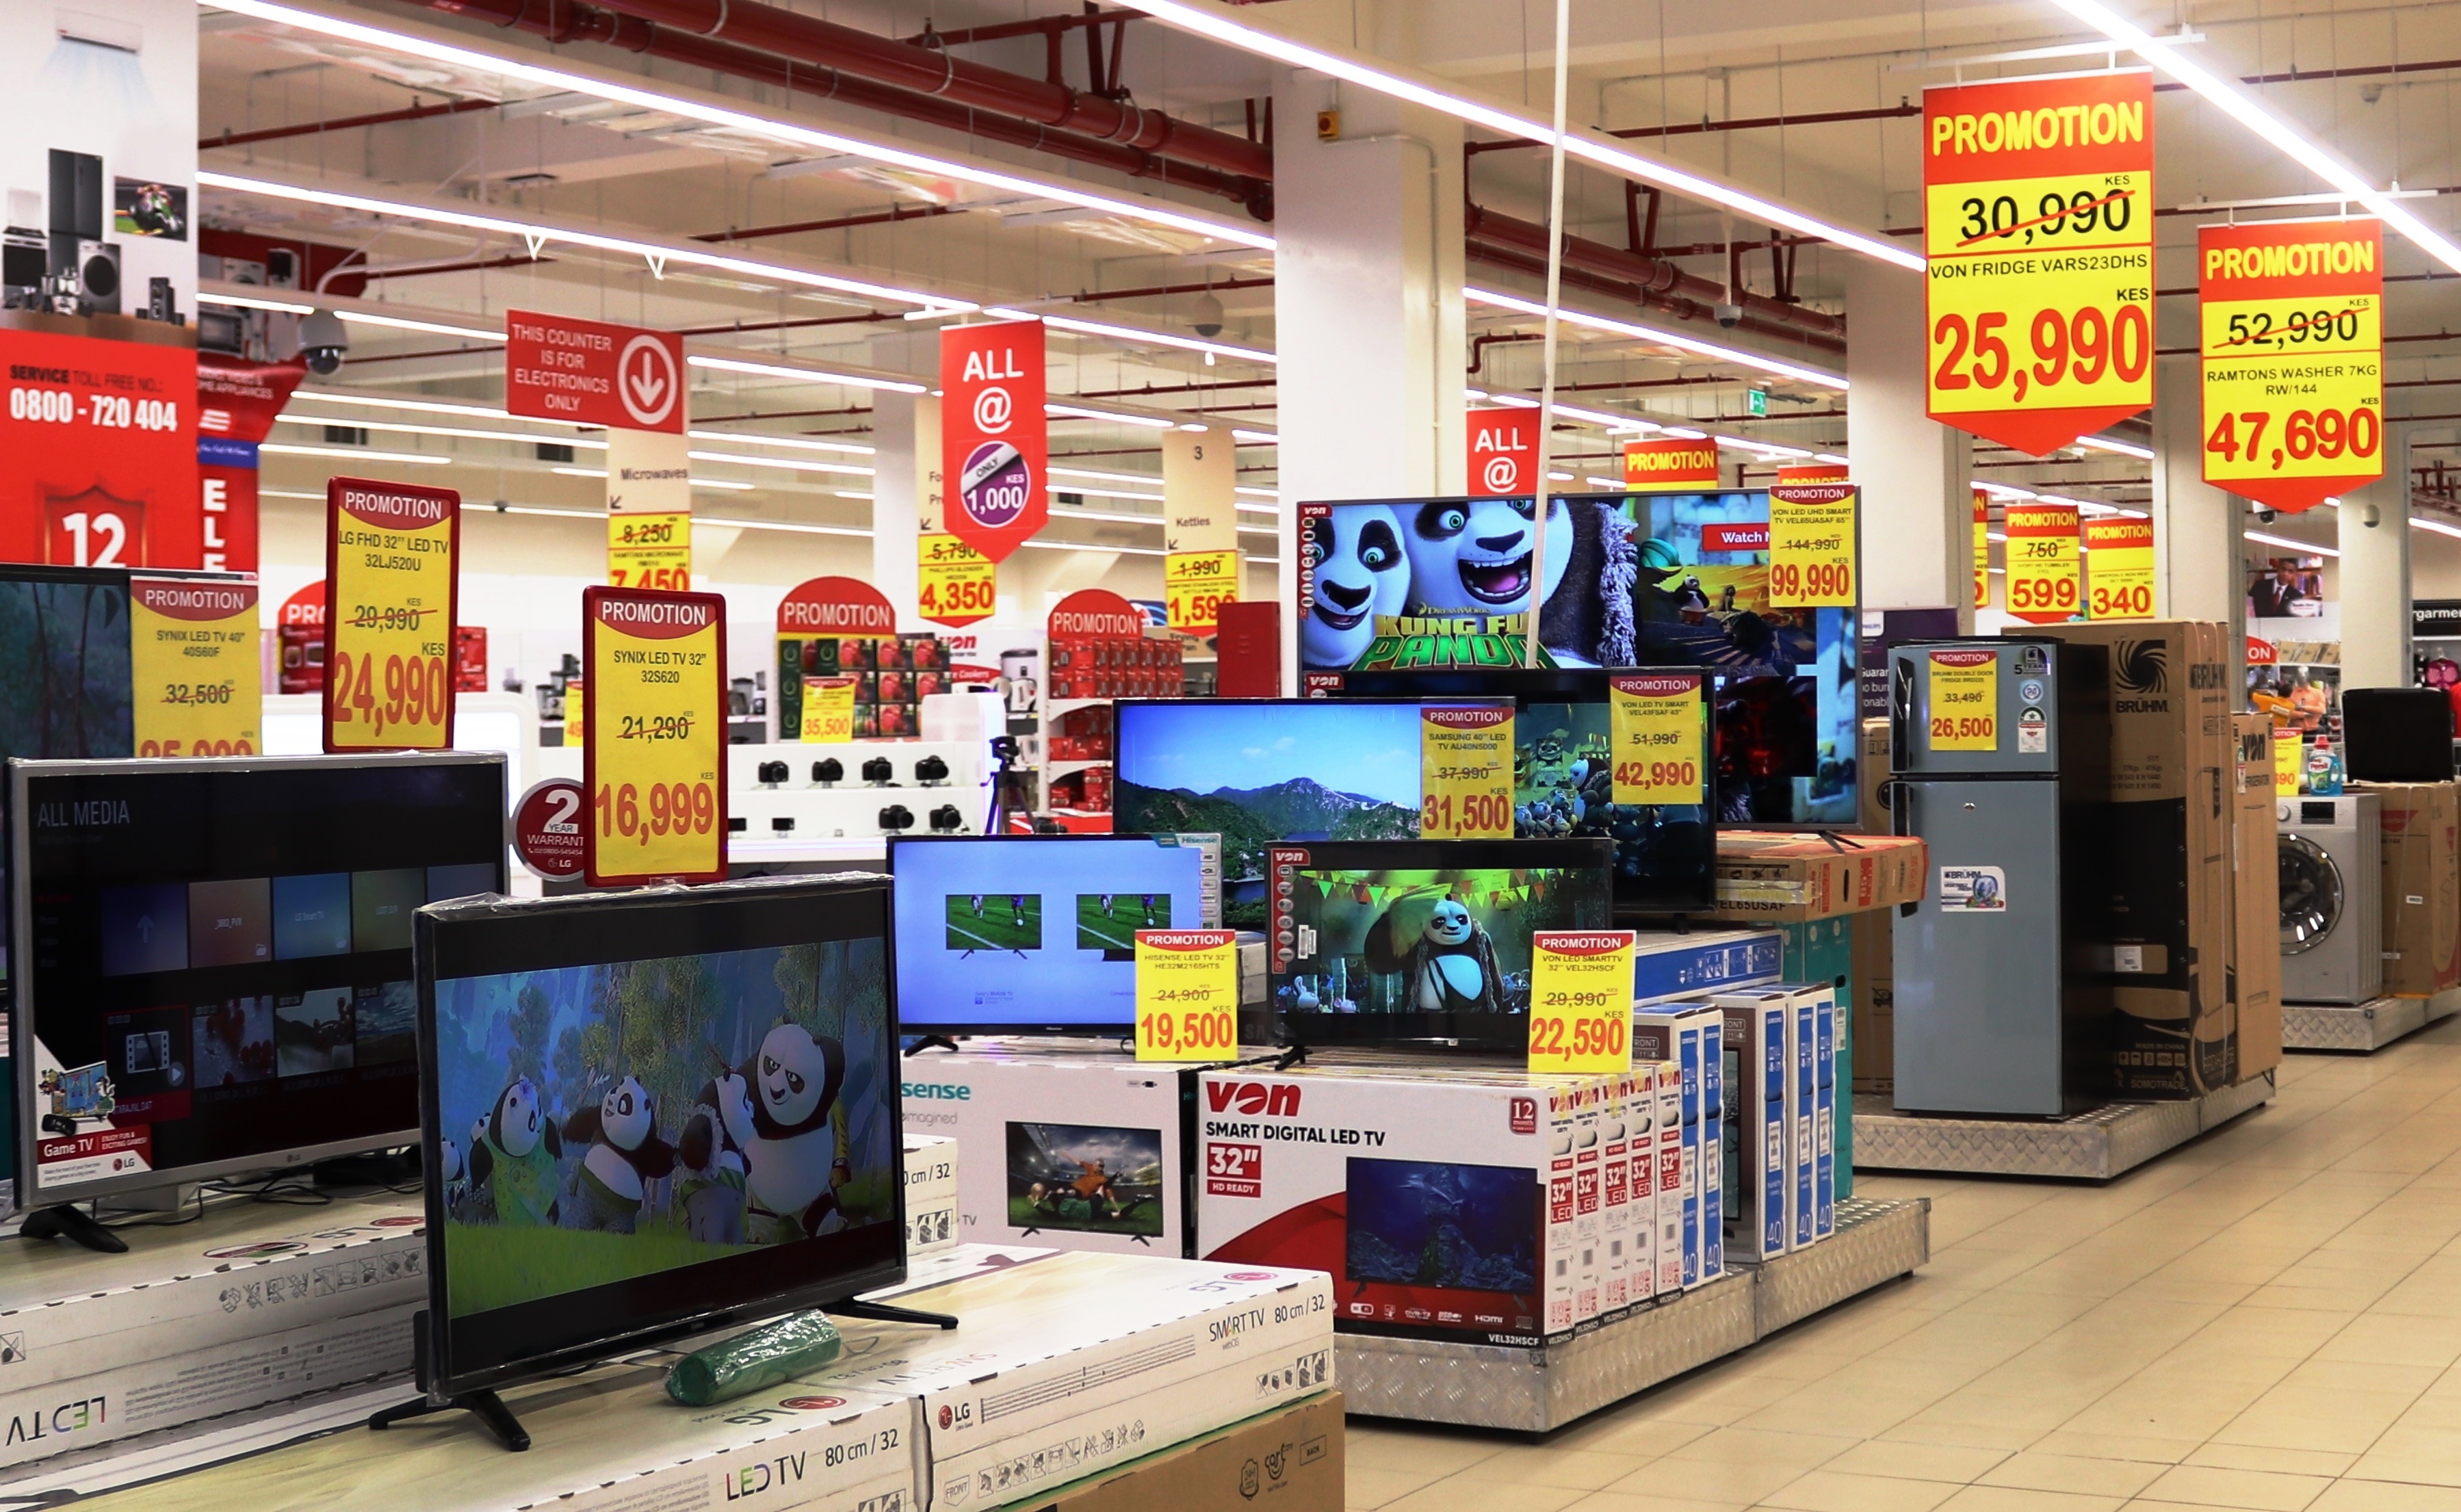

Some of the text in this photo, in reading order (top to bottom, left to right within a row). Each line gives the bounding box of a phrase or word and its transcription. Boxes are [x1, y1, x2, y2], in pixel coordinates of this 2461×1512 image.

[1933, 101, 2143, 157] PROMOTION
[2105, 176, 2131, 186] KES
[1962, 190, 2131, 245] 30,990
[1931, 255, 2148, 279] VON FRIDGE VARS23DHS
[2206, 240, 2373, 280] PROMOTION
[2117, 288, 2149, 302] KES
[2349, 298, 2369, 307] KES
[512, 324, 612, 352] THIS COUNTER
[2228, 309, 2358, 350] 52,990
[541, 350, 585, 369] IS FOR
[1935, 305, 2149, 403] 25,990
[963, 348, 1024, 382] ALL
[2207, 365, 2378, 382] RAMTONS WASHER 7KG
[10, 365, 135, 390] SERVICE TOLL FREE
[515, 367, 610, 395] ELECTRONICS
[2265, 384, 2317, 395] RW/144
[10, 387, 178, 432] 0800 720 404
[545, 393, 581, 413] ONLY
[974, 386, 1013, 434] @
[1474, 427, 1528, 453] ALL
[2206, 407, 2380, 471] 47,690
[1193, 445, 1203, 460] 3
[1628, 450, 1715, 472] PROMOTION
[621, 467, 687, 481] Microwaves
[1005, 473, 1025, 484] KES
[1483, 456, 1518, 493] @
[967, 486, 1024, 514] 1,000
[1778, 488, 1846, 499] PROMOTION
[346, 491, 443, 520] PROMOTION
[1772, 508, 1788, 517] VON
[1790, 508, 1806, 517] LED
[1825, 508, 1853, 516] SMART
[1176, 516, 1211, 528] Kettles
[2008, 512, 2078, 527] PROMOTION
[62, 512, 126, 567] 12
[339, 530, 449, 554] LG FHD LED TV
[1721, 532, 1763, 544] Watch
[2088, 524, 2152, 540] PROMOTION
[1786, 539, 1840, 553] 144,990
[2027, 542, 2059, 558] 750
[365, 553, 421, 571] 32LJ520U
[1832, 557, 1849, 565] KES
[1771, 563, 1850, 602] 99,990
[2012, 577, 2076, 608] 599
[146, 590, 246, 610] PROMOTION
[407, 598, 422, 607] KES
[920, 581, 993, 616] 4,350
[2093, 586, 2152, 615] 340
[354, 605, 421, 634] 29,990
[603, 601, 706, 626] PROMOTION
[783, 602, 890, 627] PROMOTION
[1053, 612, 1138, 635] PROMOTION
[1375, 614, 1479, 636] KUNG
[190, 631, 226, 642] LED TV
[421, 642, 446, 657] KES
[614, 650, 687, 666] SYNIX LED TV
[1936, 653, 1990, 662] PROMOTION
[640, 670, 680, 683] 32S620
[1619, 680, 1691, 690] PROMOTION
[165, 683, 231, 707] 32,500
[333, 651, 446, 738] 24,990
[1430, 712, 1503, 722] PROMOTION
[621, 716, 689, 744] 21,290
[1931, 717, 1994, 741] 26,500
[1632, 733, 1679, 747] 51,990
[1439, 767, 1489, 781] 37,990
[1615, 761, 1696, 790] 42,990
[1490, 787, 1509, 796] KES
[38, 799, 131, 829] ALL MEDIA
[595, 783, 714, 846] 16,999
[1423, 794, 1510, 837] 31,500
[549, 823, 574, 833] YEAR
[559, 858, 572, 868] LG
[1146, 935, 1225, 946] PROMOTION
[1541, 938, 1622, 949] PROMOTION
[1158, 989, 1210, 1003] 24,900
[1546, 992, 1606, 1008] 29,990
[1141, 1013, 1233, 1054] 19,500
[1530, 1018, 1625, 1063] 22,590
[1206, 1081, 1302, 1117] von
[1513, 1102, 1535, 1119] 12
[1513, 1119, 1535, 1127] month
[1206, 1122, 1386, 1146] SMART DIGITAL LED TV
[44, 1143, 77, 1158] Game
[78, 1138, 94, 1152] TV
[124, 1158, 135, 1168] LG
[911, 1163, 950, 1184] cm 32
[1661, 1175, 1680, 1189] LED
[1212, 1183, 1255, 1194] HD READY
[1606, 1190, 1627, 1205] LED
[1632, 1182, 1651, 1197] LED
[1551, 1206, 1573, 1222] LED
[1578, 1197, 1598, 1212] LED
[963, 1214, 978, 1226] TV
[1799, 1213, 1812, 1237] 40
[1818, 1204, 1831, 1228] 40
[1767, 1221, 1782, 1244] 40
[1706, 1244, 1720, 1268] 40
[1209, 1294, 1326, 1343] SMART TV 80 cm 32
[1488, 1333, 1539, 1346] VEL32HSCF
[954, 1403, 970, 1422] LG
[726, 1428, 900, 1502] LED TV 80 cm 32
[946, 1481, 968, 1499] FRONT
